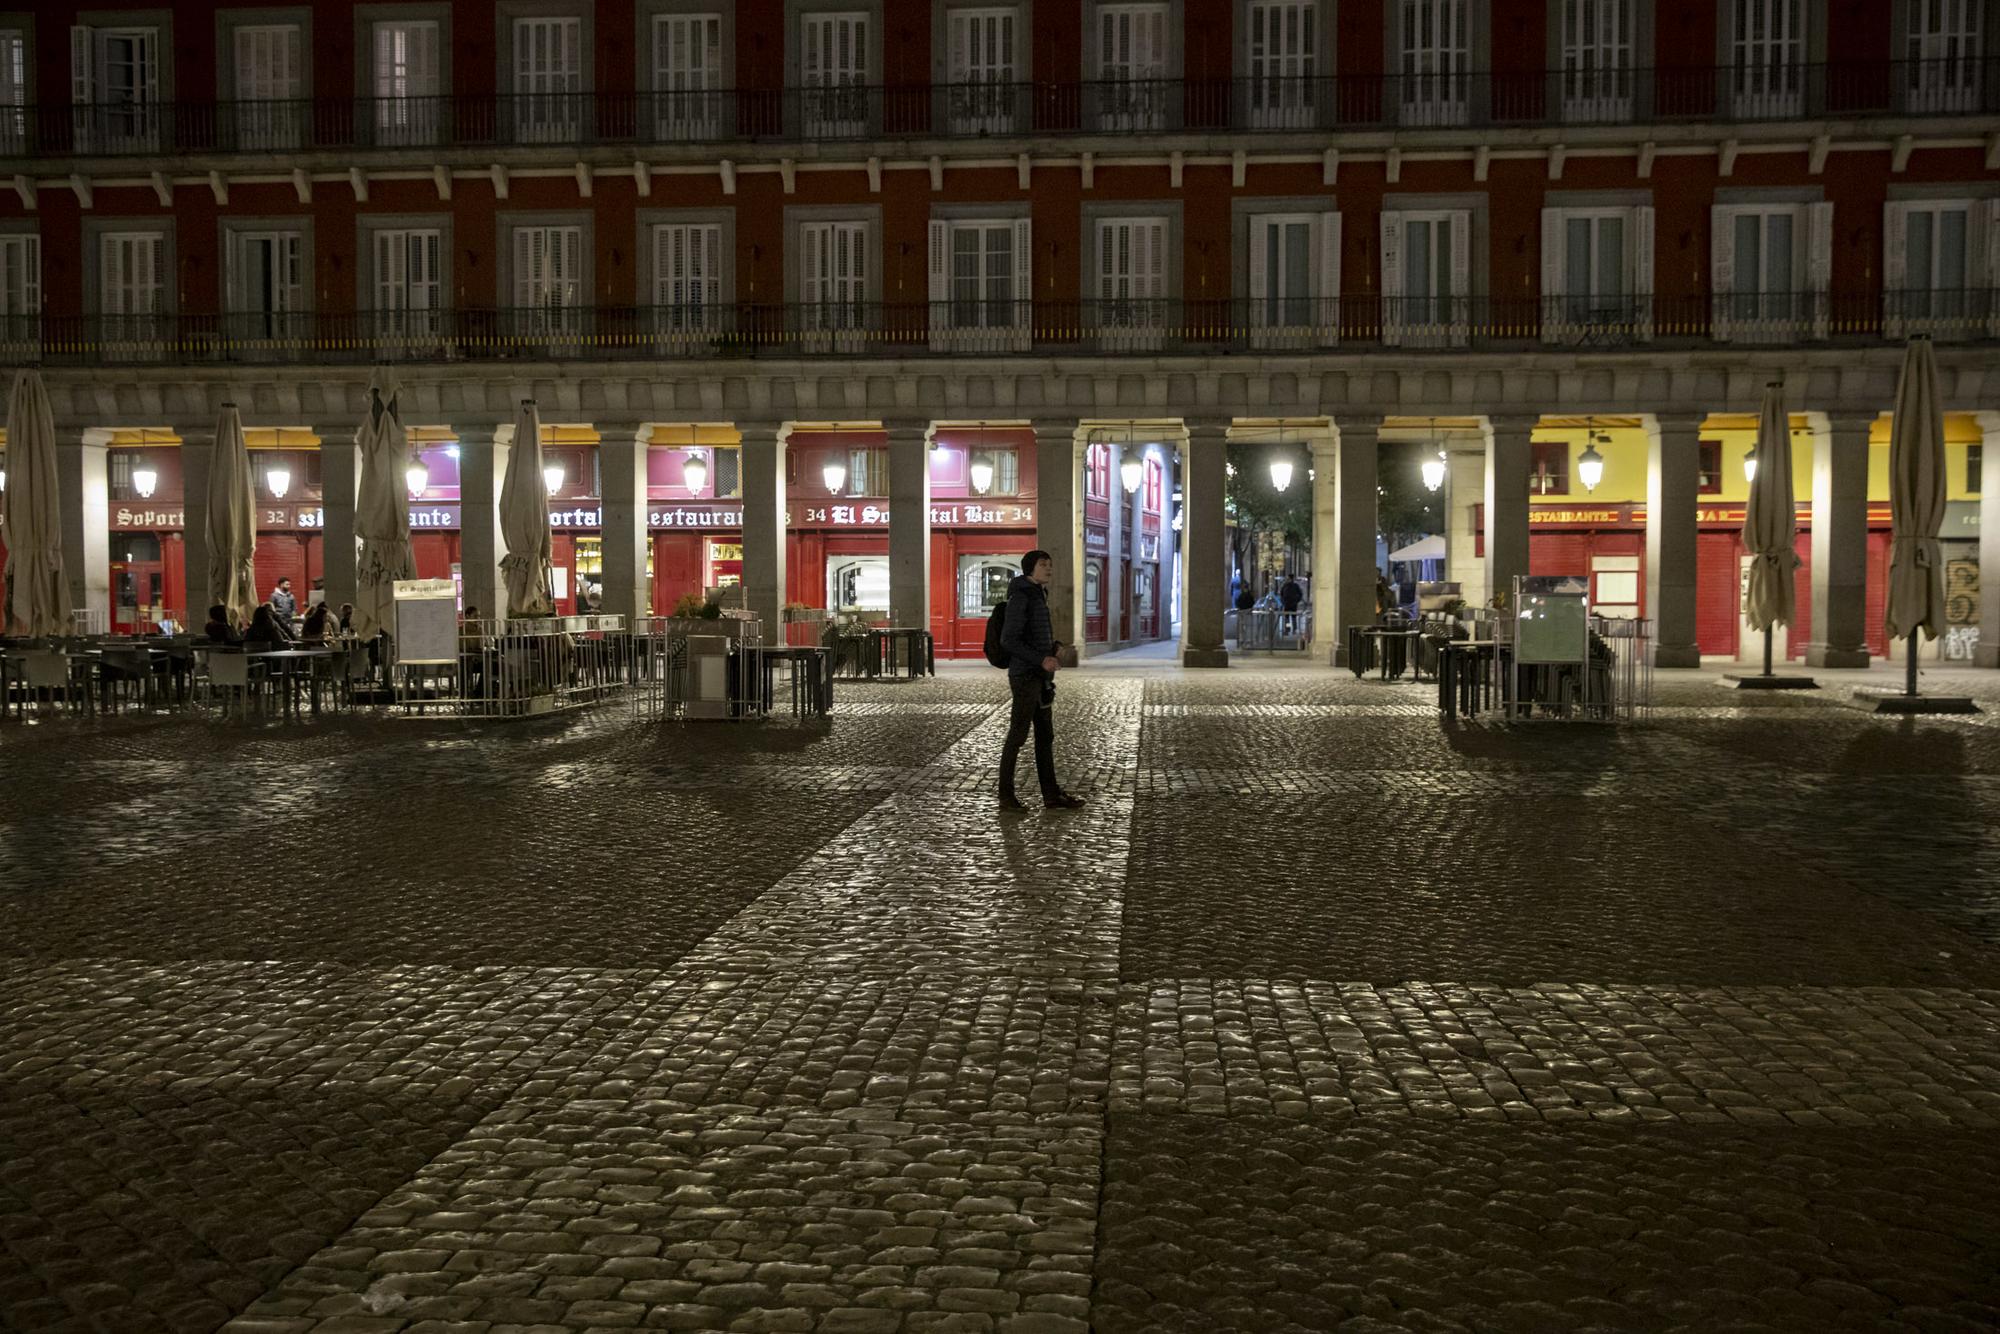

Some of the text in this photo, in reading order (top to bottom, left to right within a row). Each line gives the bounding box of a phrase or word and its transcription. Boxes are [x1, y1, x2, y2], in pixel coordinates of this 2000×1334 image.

[266, 511, 285, 524] 32
[806, 508, 826, 522] 34
[831, 505, 856, 524] El
[964, 505, 1006, 523] Bar
[1011, 507, 1032, 521] 34
